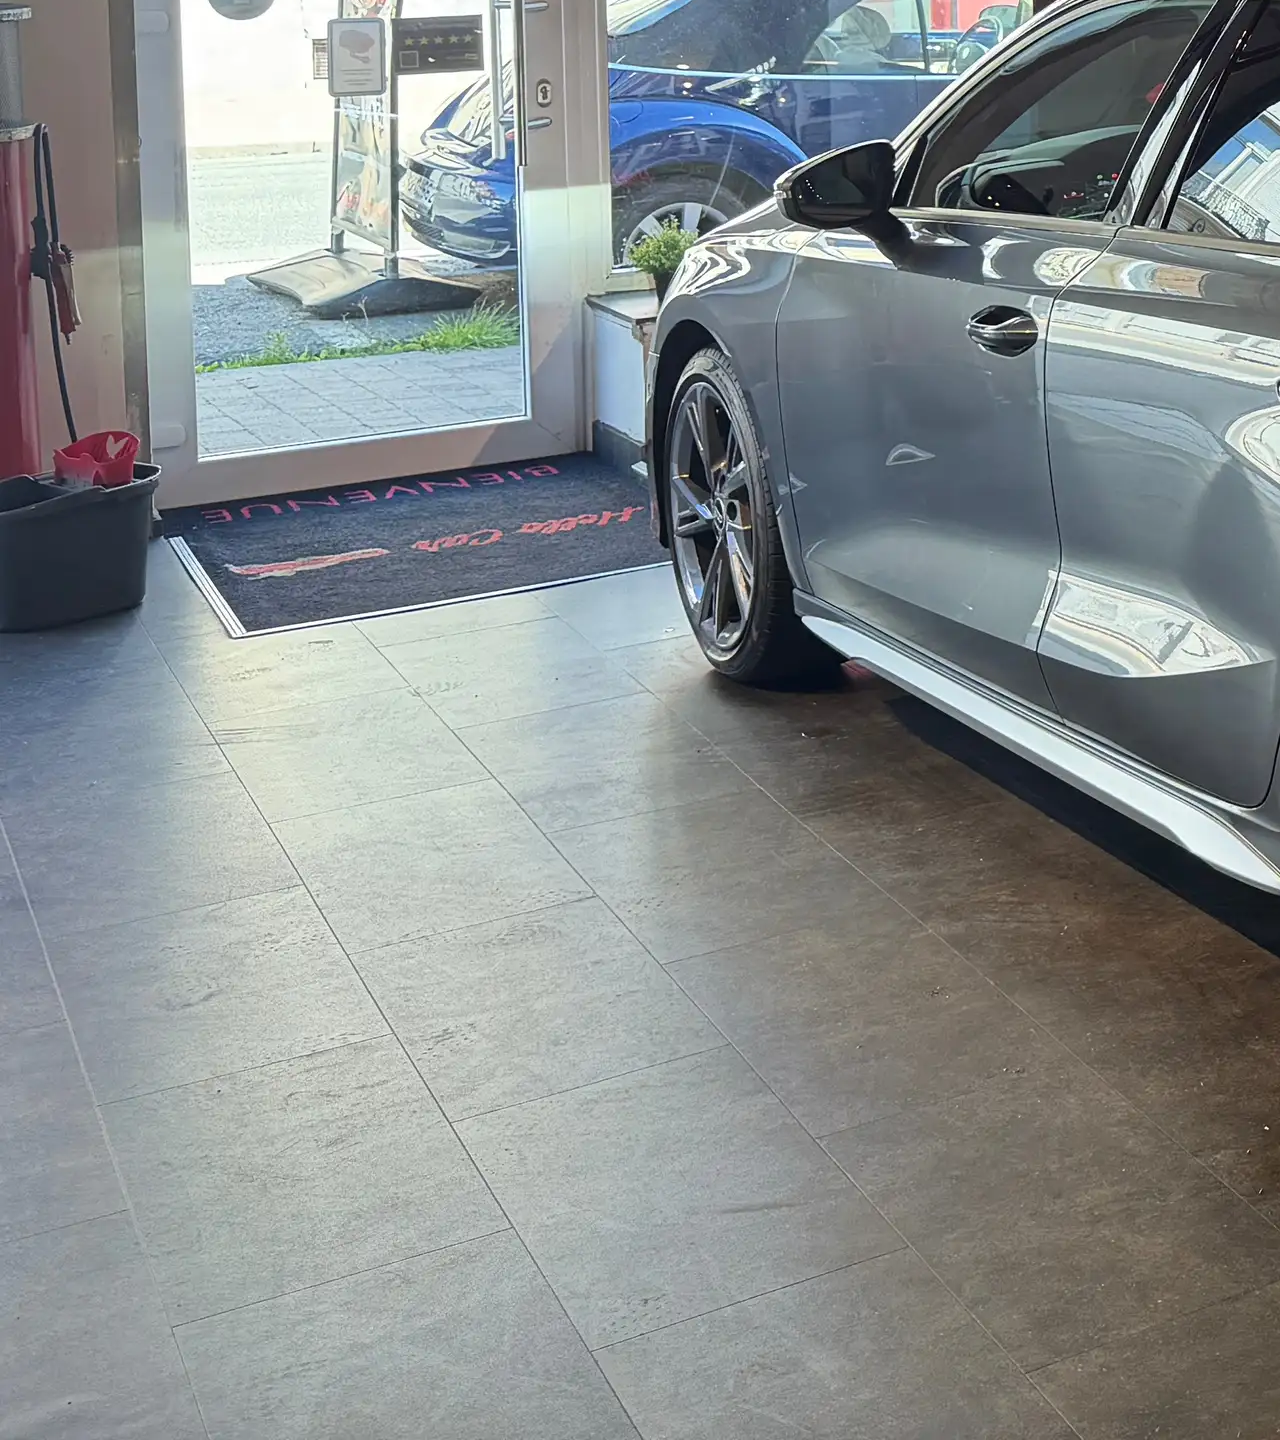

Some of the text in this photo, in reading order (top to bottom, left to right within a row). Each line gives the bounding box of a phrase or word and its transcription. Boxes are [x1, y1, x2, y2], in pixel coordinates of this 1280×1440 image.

[201, 464, 559, 525] BIENVENUE
[411, 506, 645, 553] Hello Car
